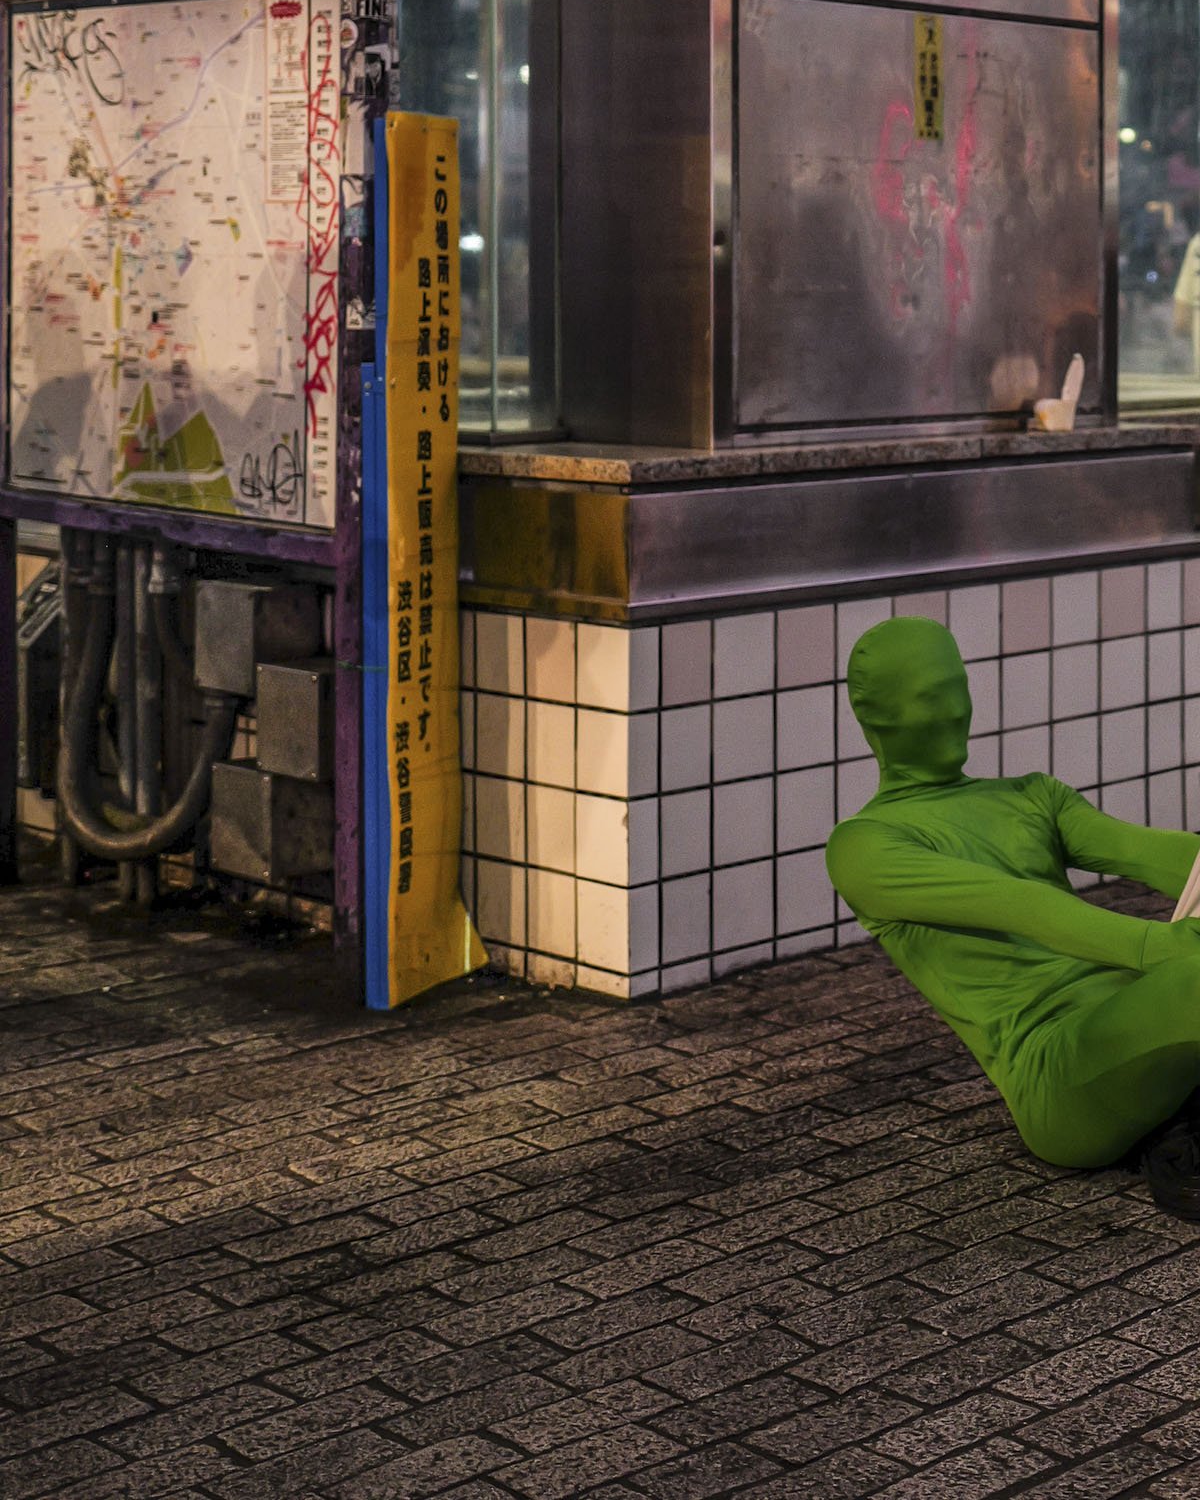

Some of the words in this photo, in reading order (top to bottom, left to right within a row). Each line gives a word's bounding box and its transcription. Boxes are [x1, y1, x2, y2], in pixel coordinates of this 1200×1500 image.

[433, 155, 451, 422] この場所における
[416, 257, 434, 752] 路上演奏・路上販売は禁止です。
[395, 581, 414, 895] 渋谷区・渋谷警察署
